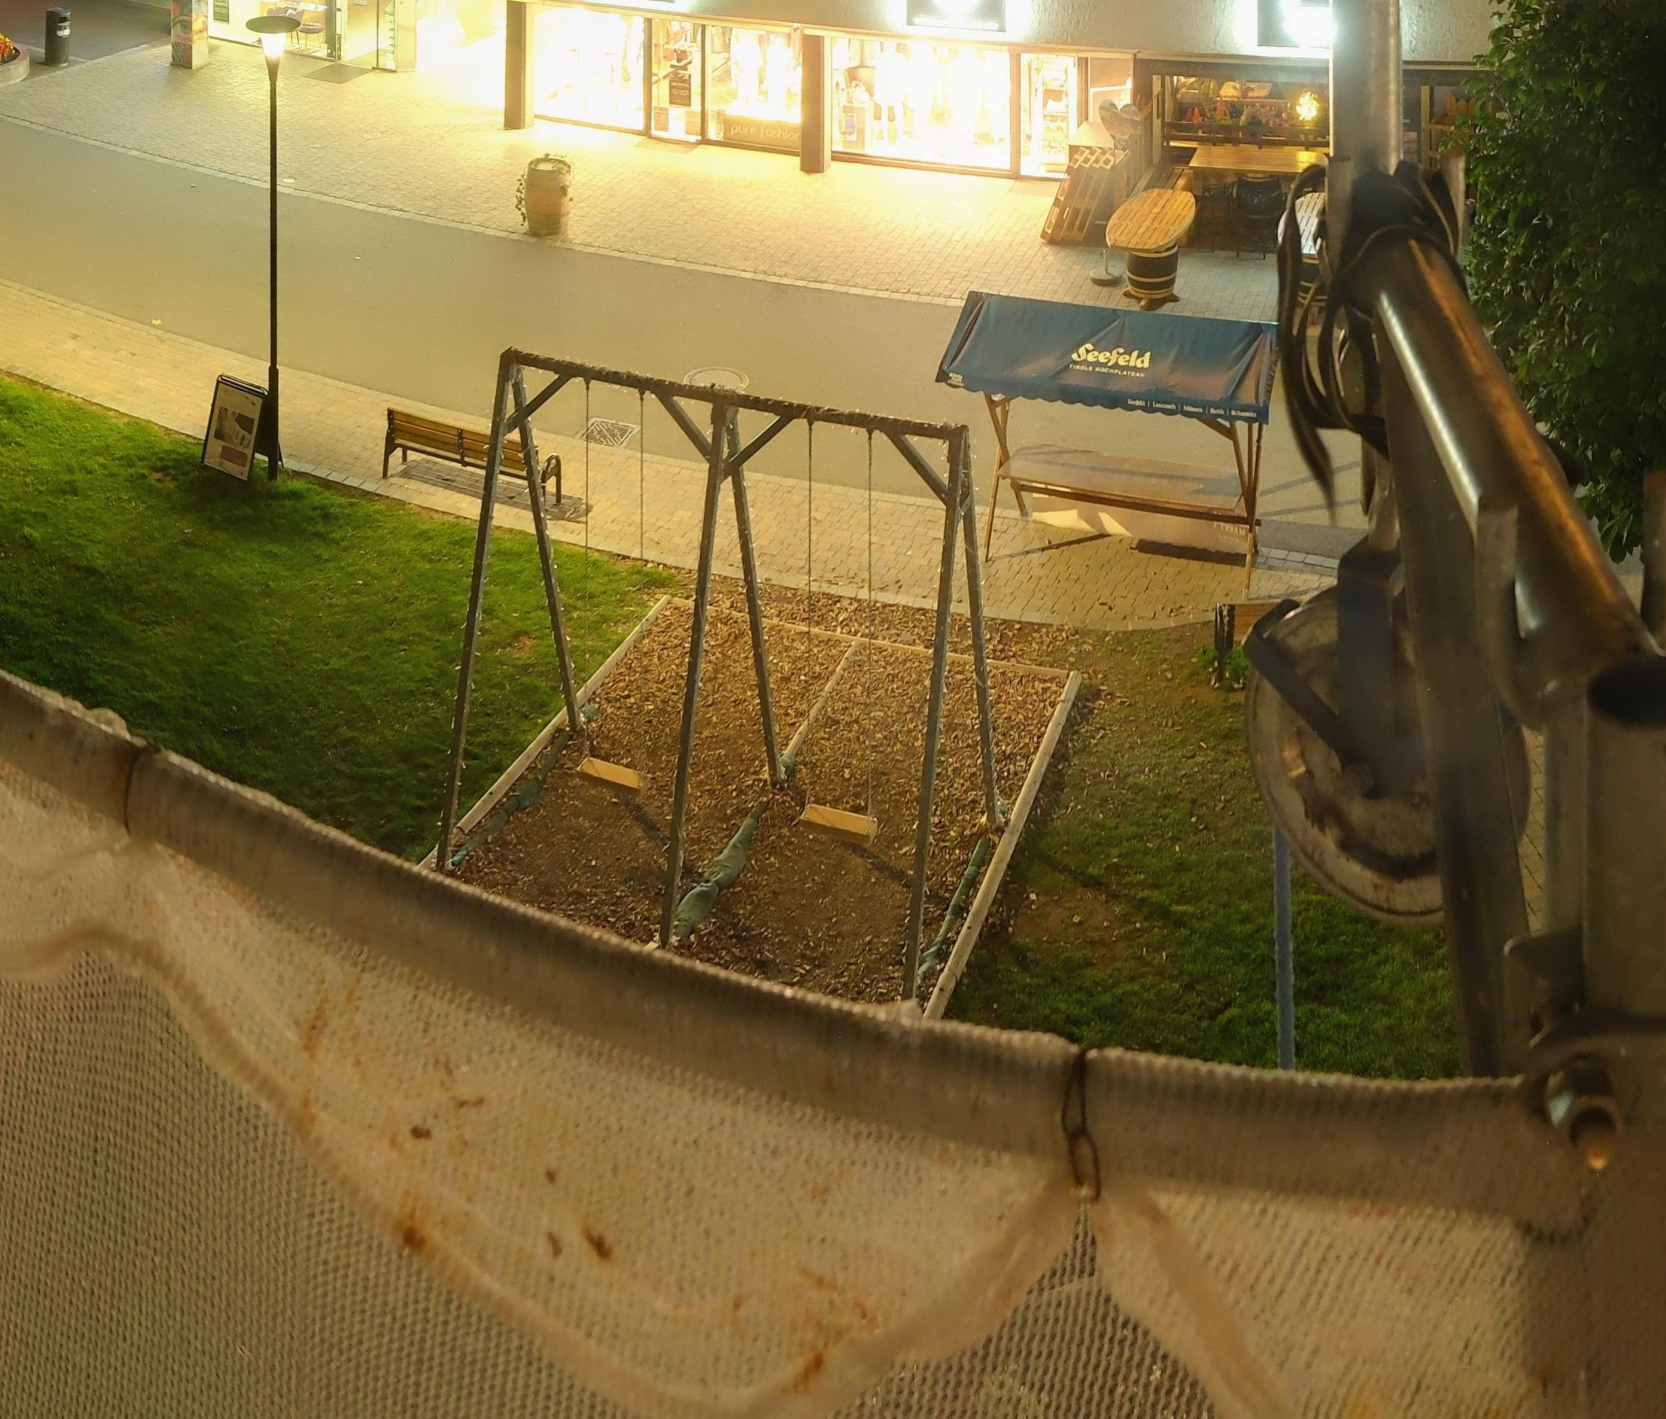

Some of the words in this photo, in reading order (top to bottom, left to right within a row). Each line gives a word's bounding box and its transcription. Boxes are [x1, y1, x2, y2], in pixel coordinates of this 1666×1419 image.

[731, 123, 757, 137] pure
[1070, 343, 1151, 369] Seefeld
[1069, 363, 1093, 373] TIROLS
[1095, 367, 1145, 379] HOCHPLATEAU
